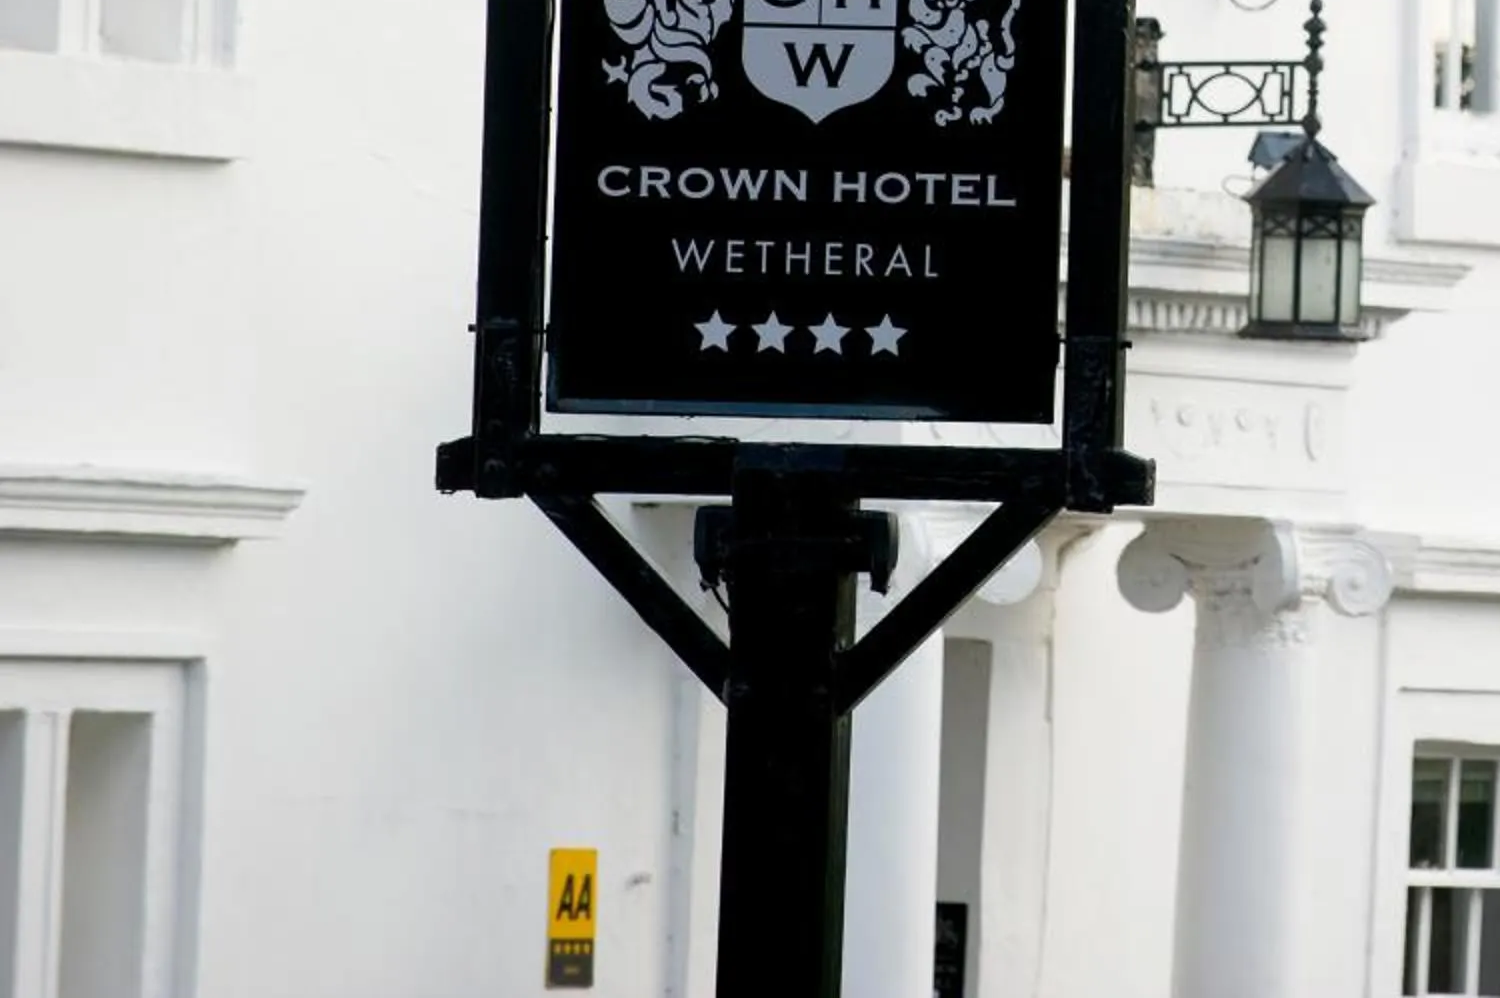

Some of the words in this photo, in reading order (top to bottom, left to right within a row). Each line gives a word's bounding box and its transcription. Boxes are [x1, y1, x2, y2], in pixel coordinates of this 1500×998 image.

[783, 42, 855, 88] W
[597, 165, 808, 201] CROWN
[832, 171, 1017, 206] HOTEL
[671, 238, 939, 278] WETHERAL
[556, 874, 592, 921] AA
